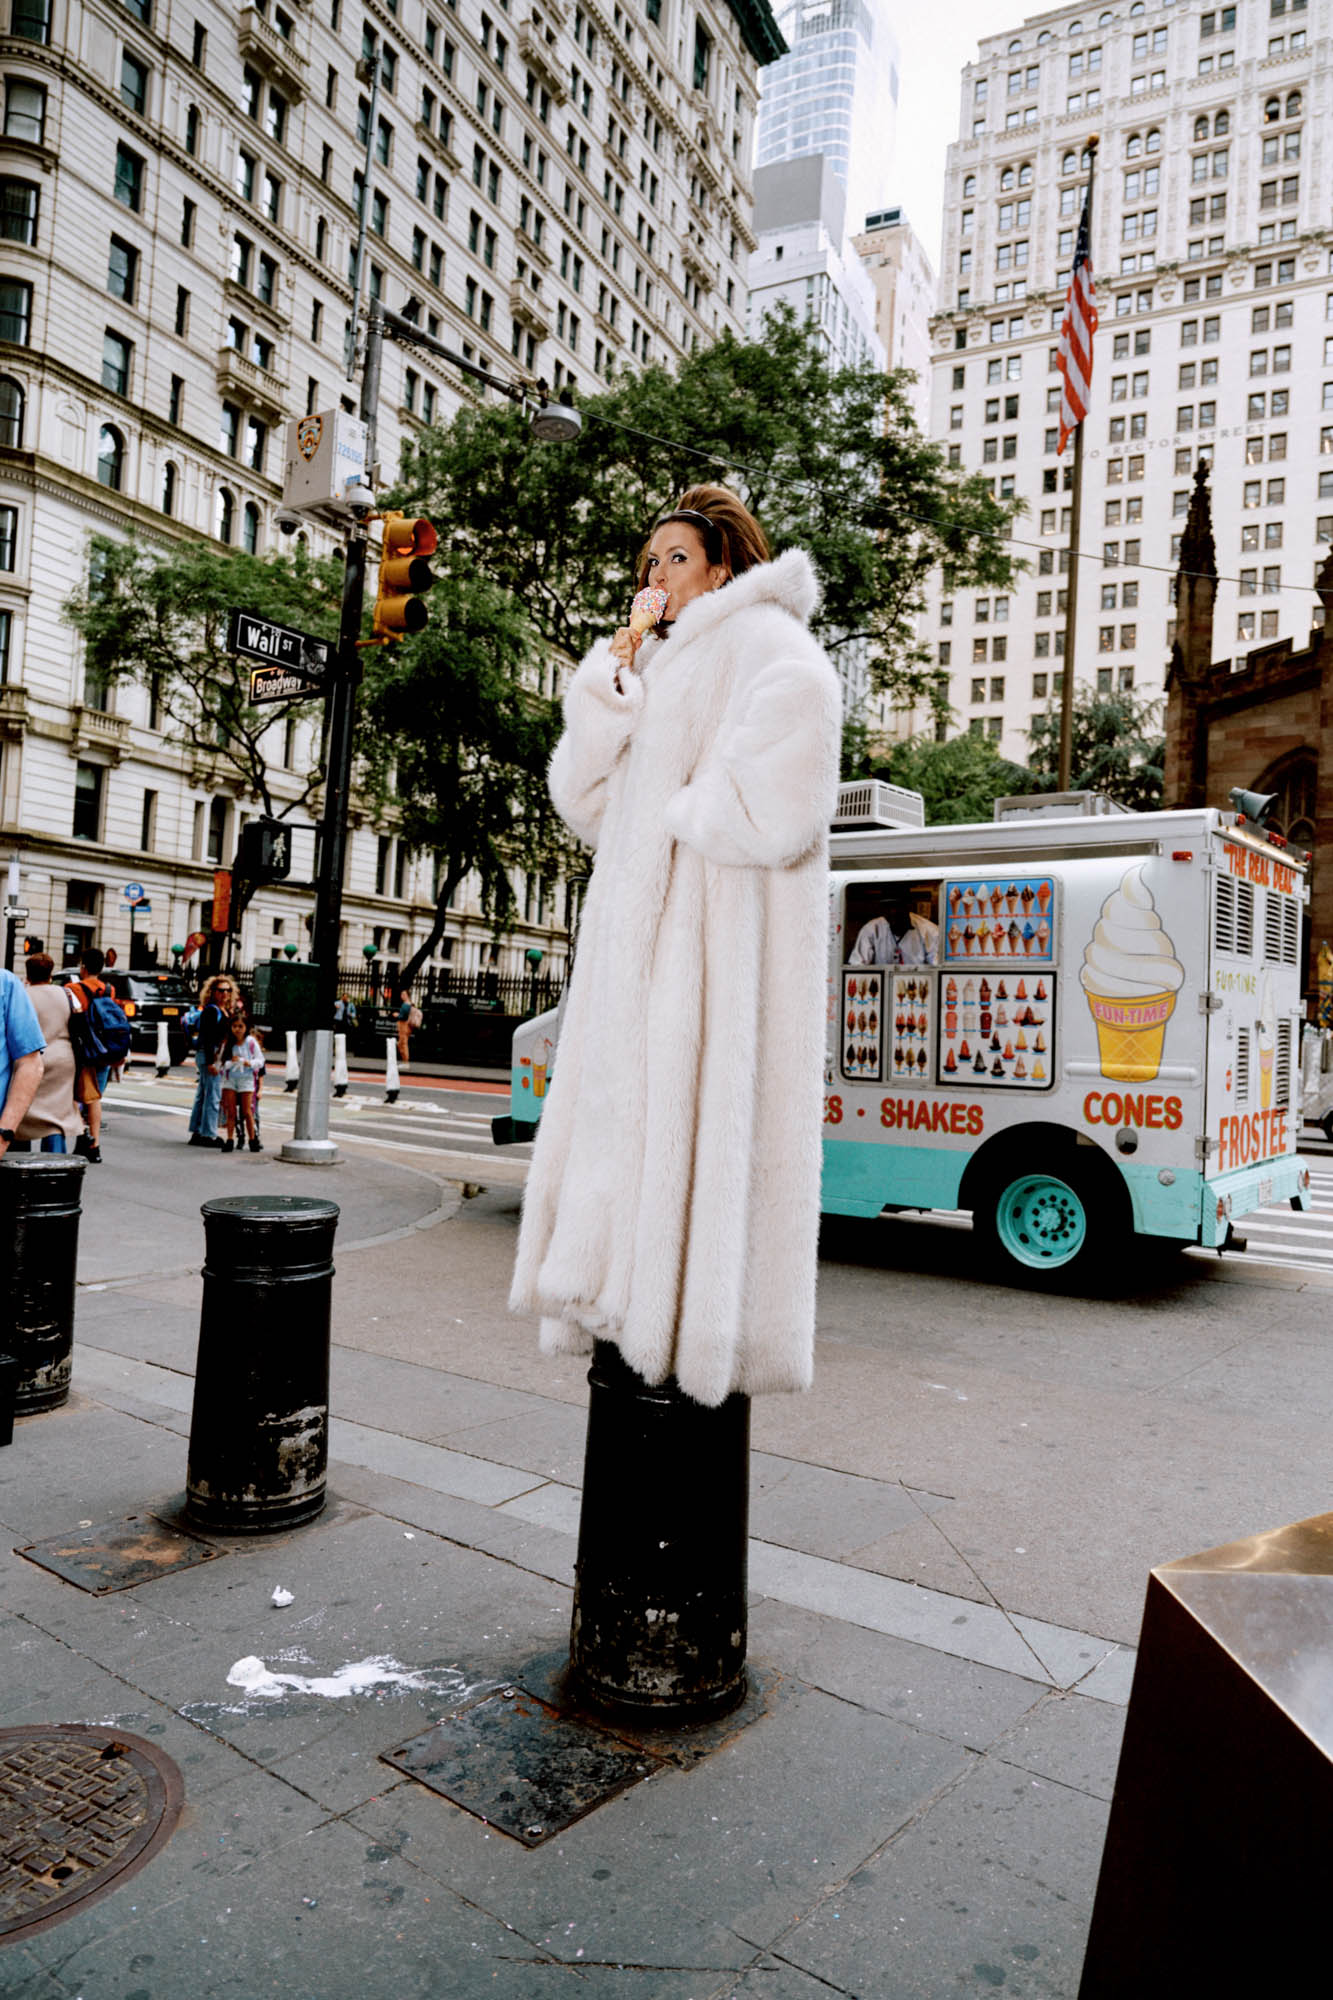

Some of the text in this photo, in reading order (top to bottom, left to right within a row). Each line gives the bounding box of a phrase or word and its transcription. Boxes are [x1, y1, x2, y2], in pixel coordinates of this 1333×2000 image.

[1066, 423, 1266, 464] TO RECTOR STREET
[247, 625, 281, 657] Wall
[256, 673, 303, 695] Broadway
[1248, 851, 1270, 887] REAL
[1094, 1001, 1169, 1025] FUN-TIME
[880, 1097, 985, 1136] SHAKES
[1083, 1091, 1184, 1131] CONES
[1218, 1106, 1288, 1172] FROSTEE
